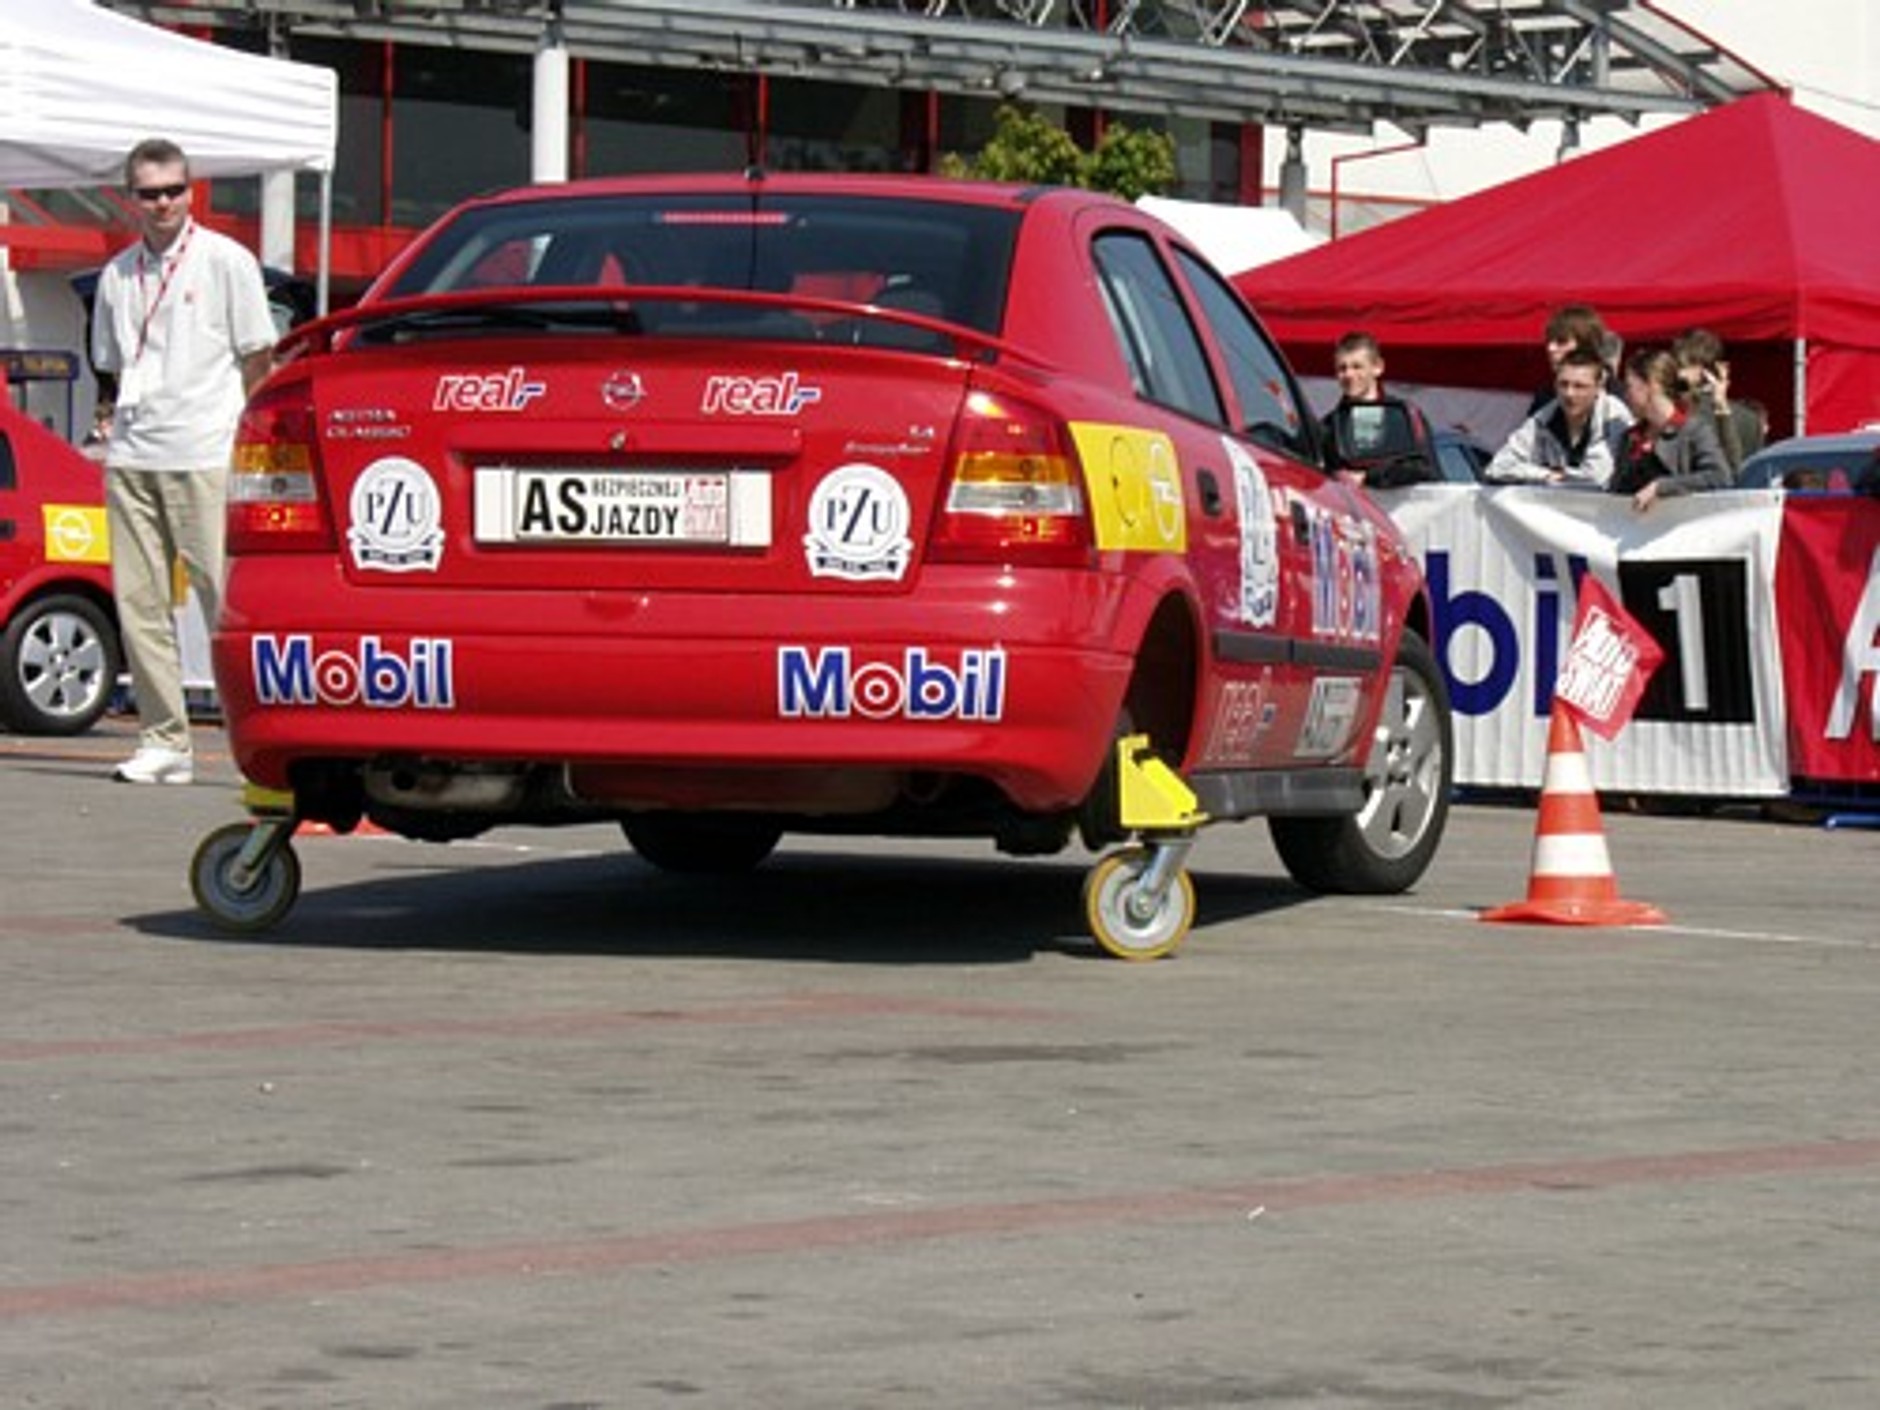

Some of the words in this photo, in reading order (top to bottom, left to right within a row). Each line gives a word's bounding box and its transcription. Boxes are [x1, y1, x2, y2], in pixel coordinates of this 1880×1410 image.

[367, 480, 425, 537] PZU
[520, 477, 588, 534] AS
[591, 478, 680, 498] BEZPIECZNEJ
[827, 486, 893, 546] PZU
[590, 503, 679, 536] JAZDY
[253, 636, 454, 706] Mobil
[779, 646, 1004, 720] Mobil
